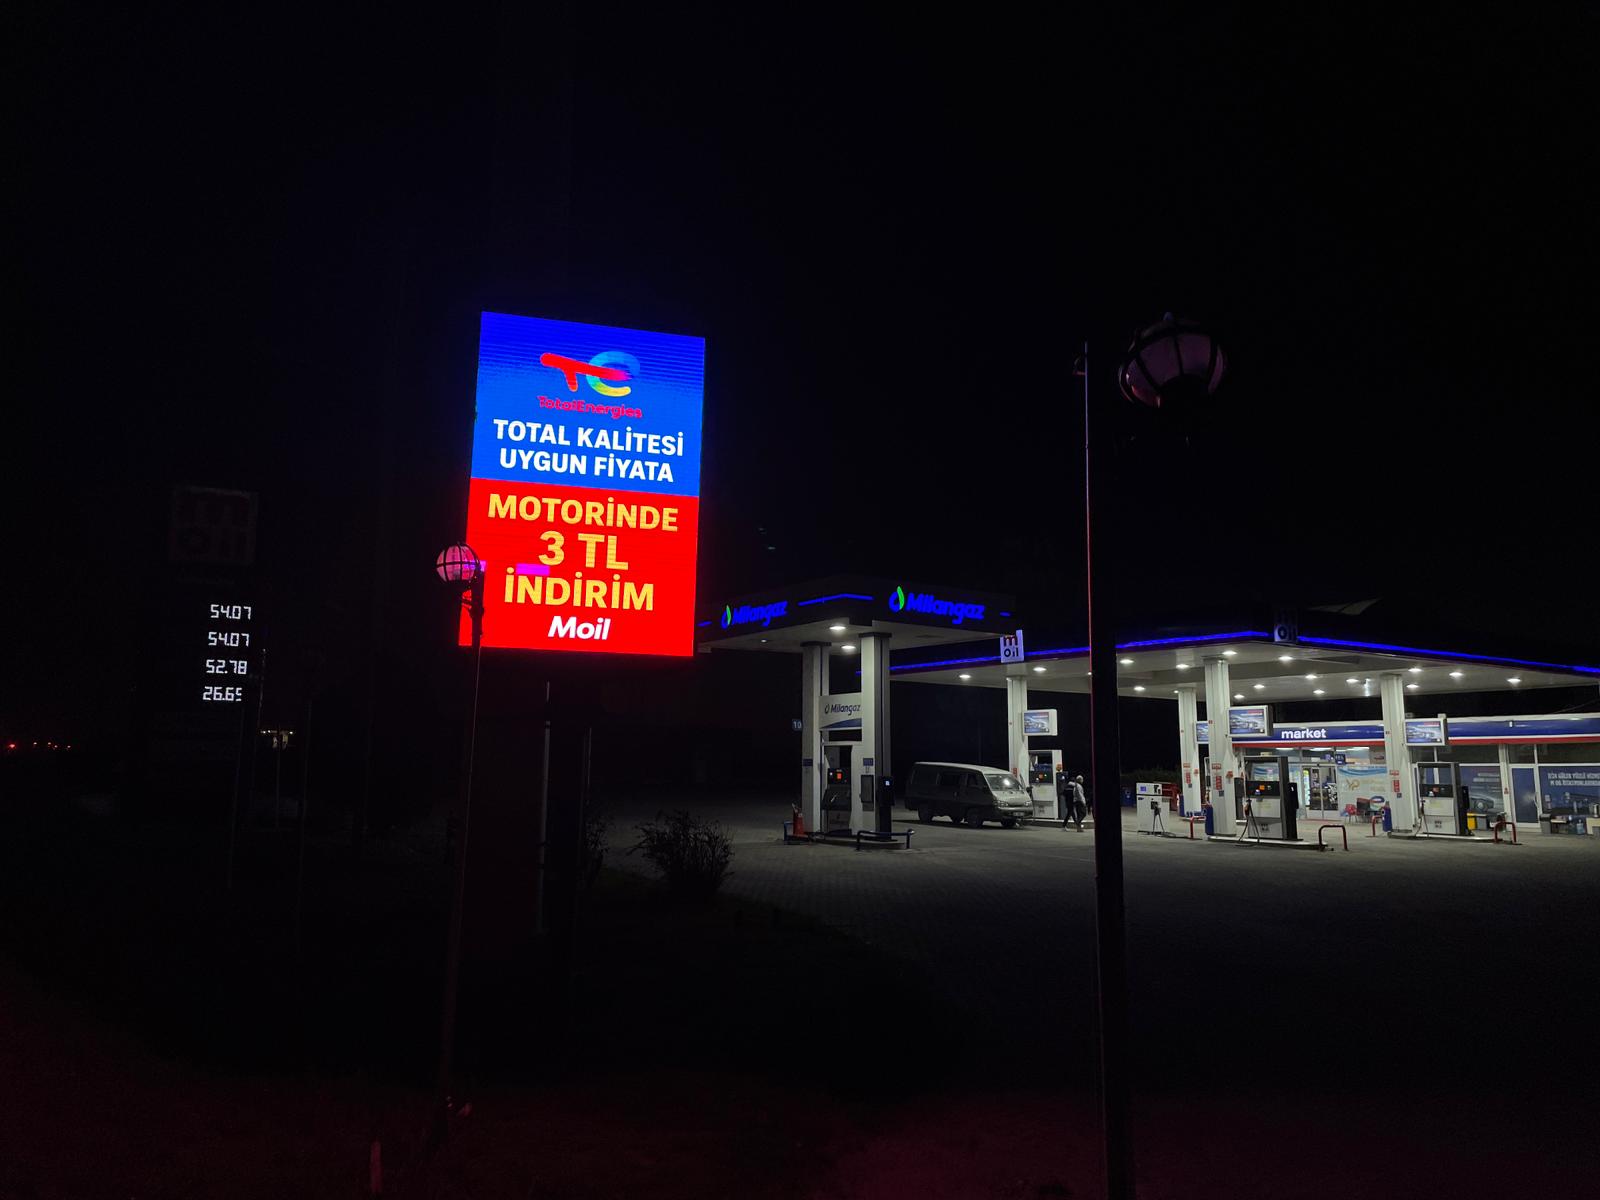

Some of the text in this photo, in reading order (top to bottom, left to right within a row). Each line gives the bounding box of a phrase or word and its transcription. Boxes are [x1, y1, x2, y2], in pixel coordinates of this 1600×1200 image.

[537, 396, 643, 419] TotalEnergies
[493, 418, 684, 457] TOTAL KALİTESİ
[499, 447, 674, 482] UYGUN FİYATA
[487, 493, 679, 532] MOTORİNDE
[538, 530, 629, 571] 3 TL
[504, 566, 654, 611] İNDİRİM
[209, 603, 252, 620] 54.07
[732, 600, 788, 626] Milangaz
[906, 592, 985, 624] Milangaz
[207, 631, 250, 647] 54.07
[547, 615, 611, 641] Moil
[205, 659, 248, 675] 52.78
[830, 703, 861, 716] Milangaz
[1281, 727, 1327, 740] market
